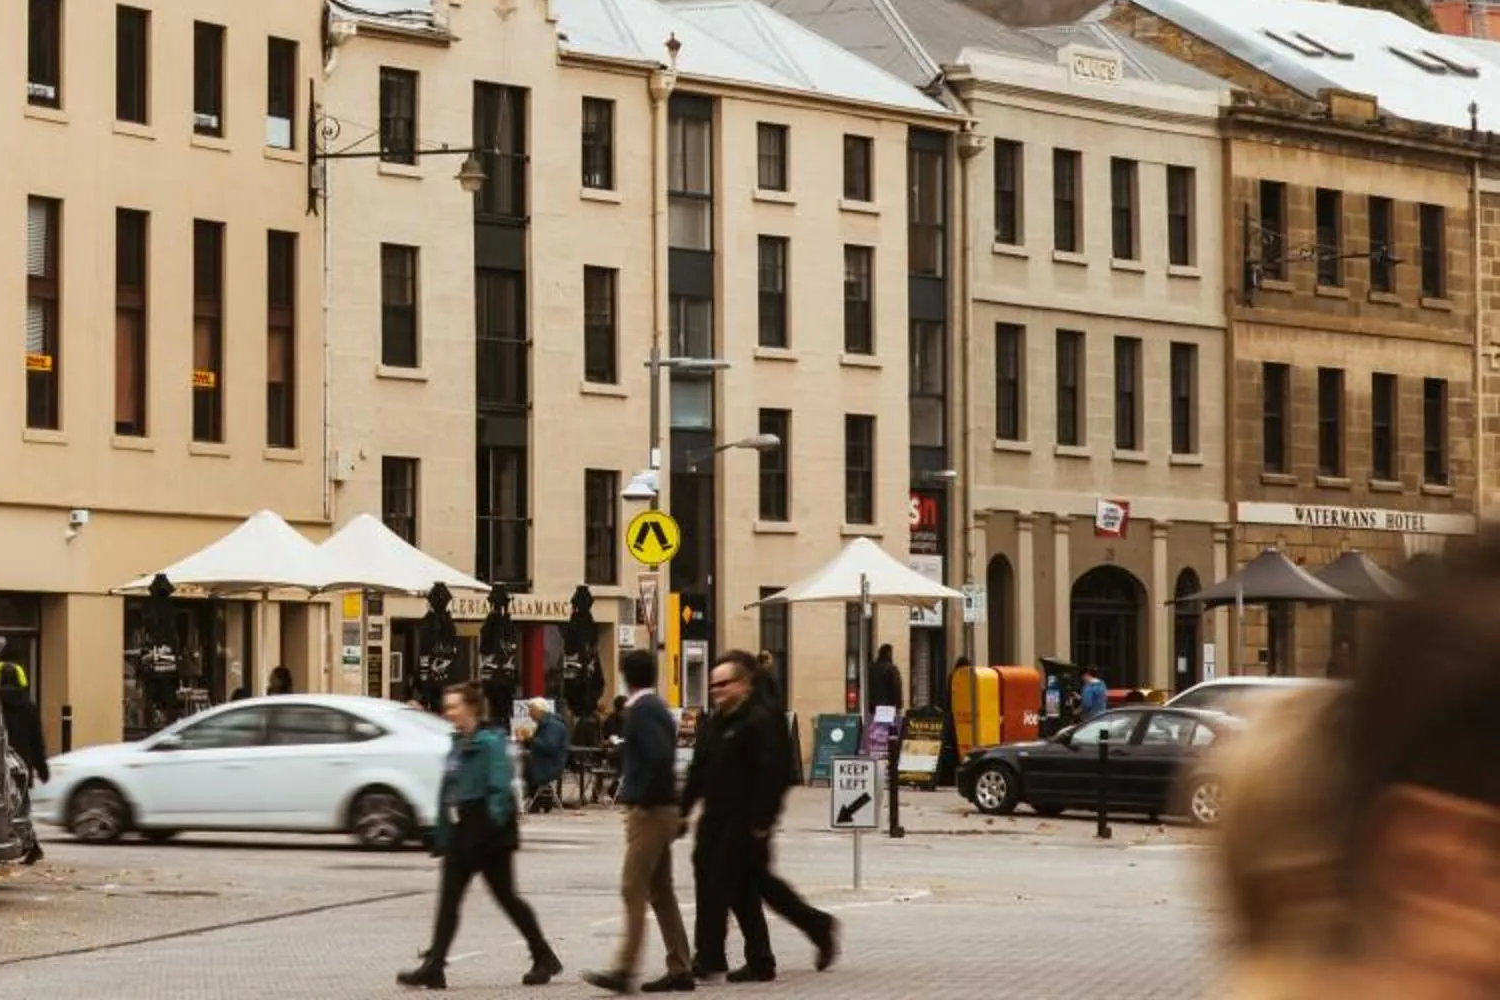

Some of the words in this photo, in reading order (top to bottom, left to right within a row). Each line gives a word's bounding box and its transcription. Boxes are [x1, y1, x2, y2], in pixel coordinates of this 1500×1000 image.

[1295, 507, 1376, 528] WATERMANS
[1385, 513, 1426, 531] HOTEL
[451, 599, 489, 616] LERIA
[508, 600, 570, 617] ALAMANC
[839, 763, 869, 776] KEEP
[839, 778, 867, 790] LEFT
